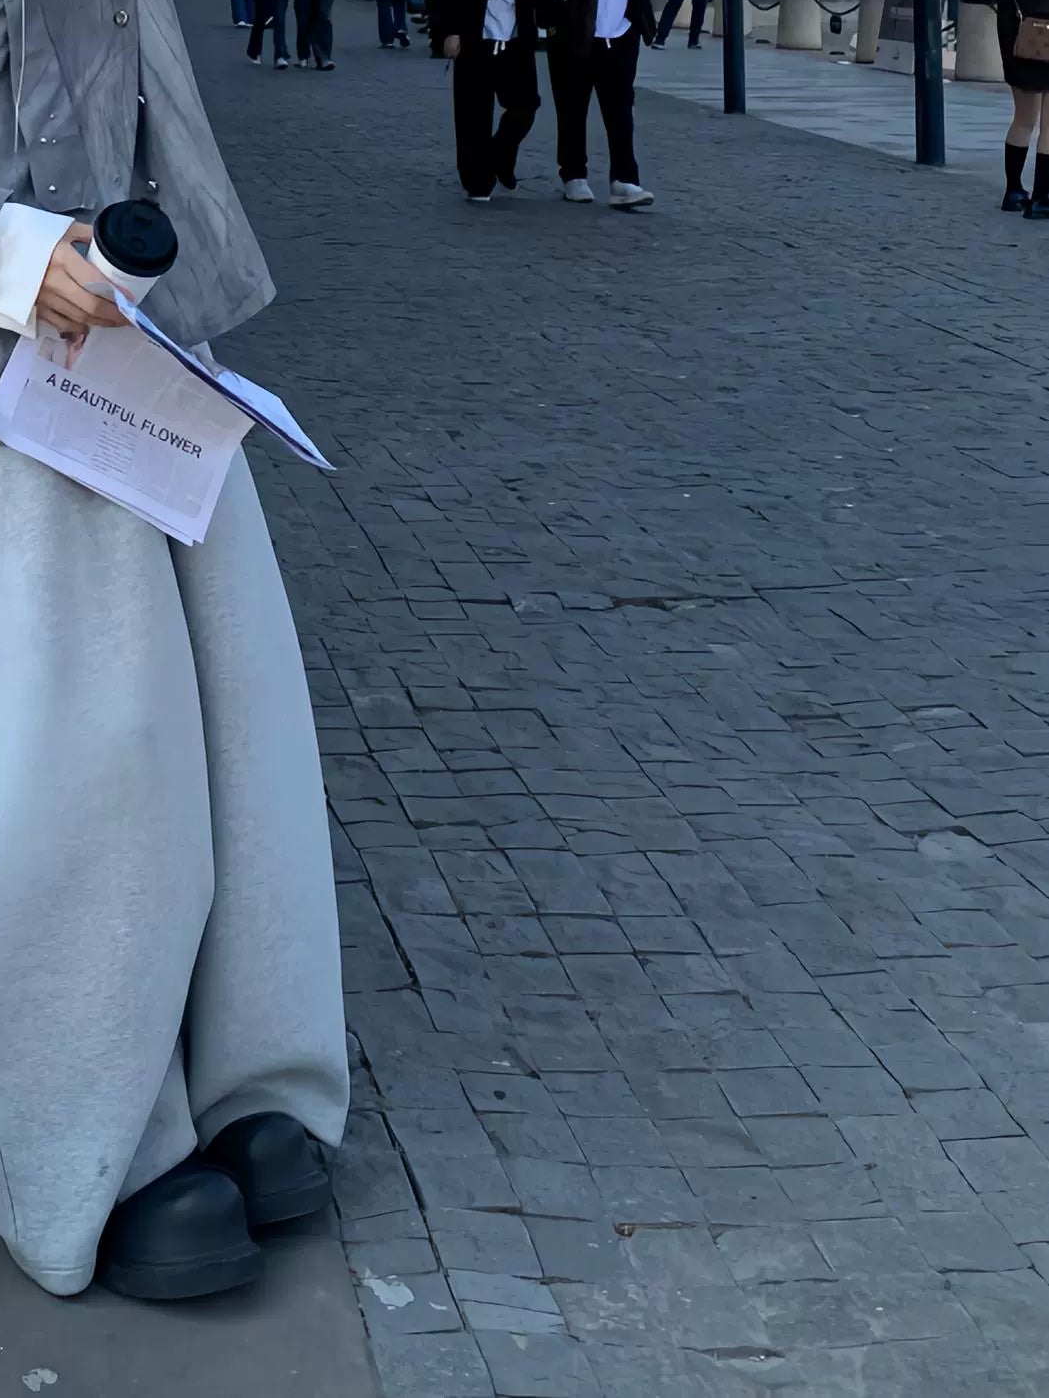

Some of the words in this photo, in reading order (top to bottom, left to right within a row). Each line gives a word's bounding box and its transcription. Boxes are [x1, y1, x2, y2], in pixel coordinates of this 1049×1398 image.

[46, 373, 56, 387] A
[60, 378, 138, 428] BEAUTIFUL
[140, 418, 203, 459] FLOWER
